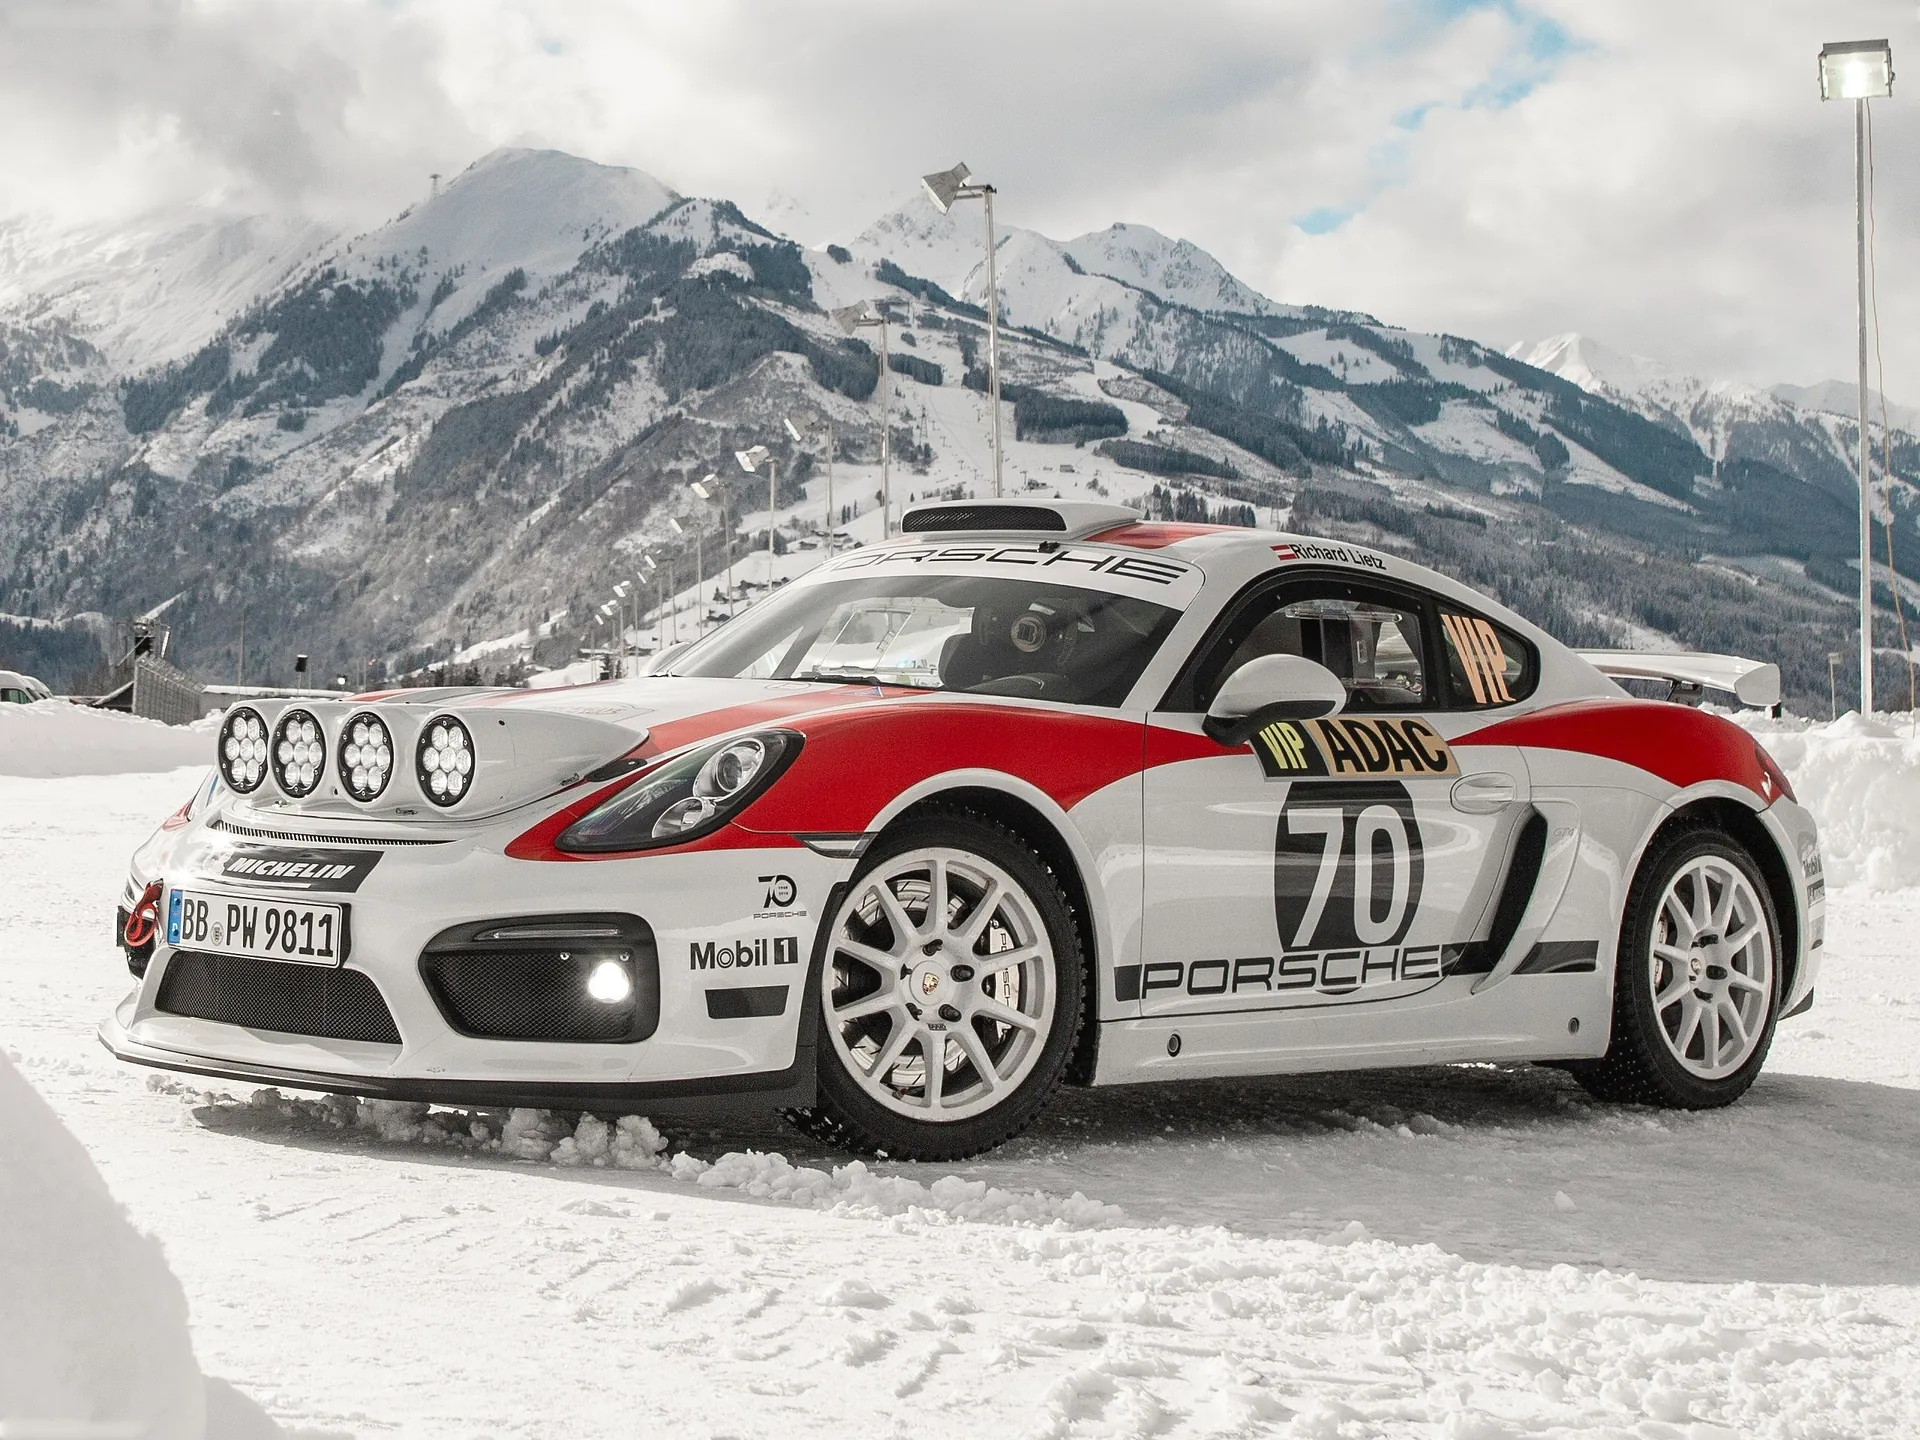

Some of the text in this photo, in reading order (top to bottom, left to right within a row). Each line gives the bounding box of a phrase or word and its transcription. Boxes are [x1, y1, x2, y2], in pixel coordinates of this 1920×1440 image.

[1288, 543, 1387, 570] Richard Lietz
[1441, 614, 1517, 704] VIP
[1259, 719, 1449, 773] VIP ADAC
[227, 857, 356, 880] MICHELIN
[1287, 804, 1411, 947] 70
[758, 874, 798, 909] 70
[182, 899, 209, 942] BB
[226, 904, 258, 949] PW
[265, 908, 334, 957] 9811
[753, 910, 807, 919] PORSCHE
[690, 938, 768, 970] Mobil
[1142, 944, 1442, 999] PORSCHE
